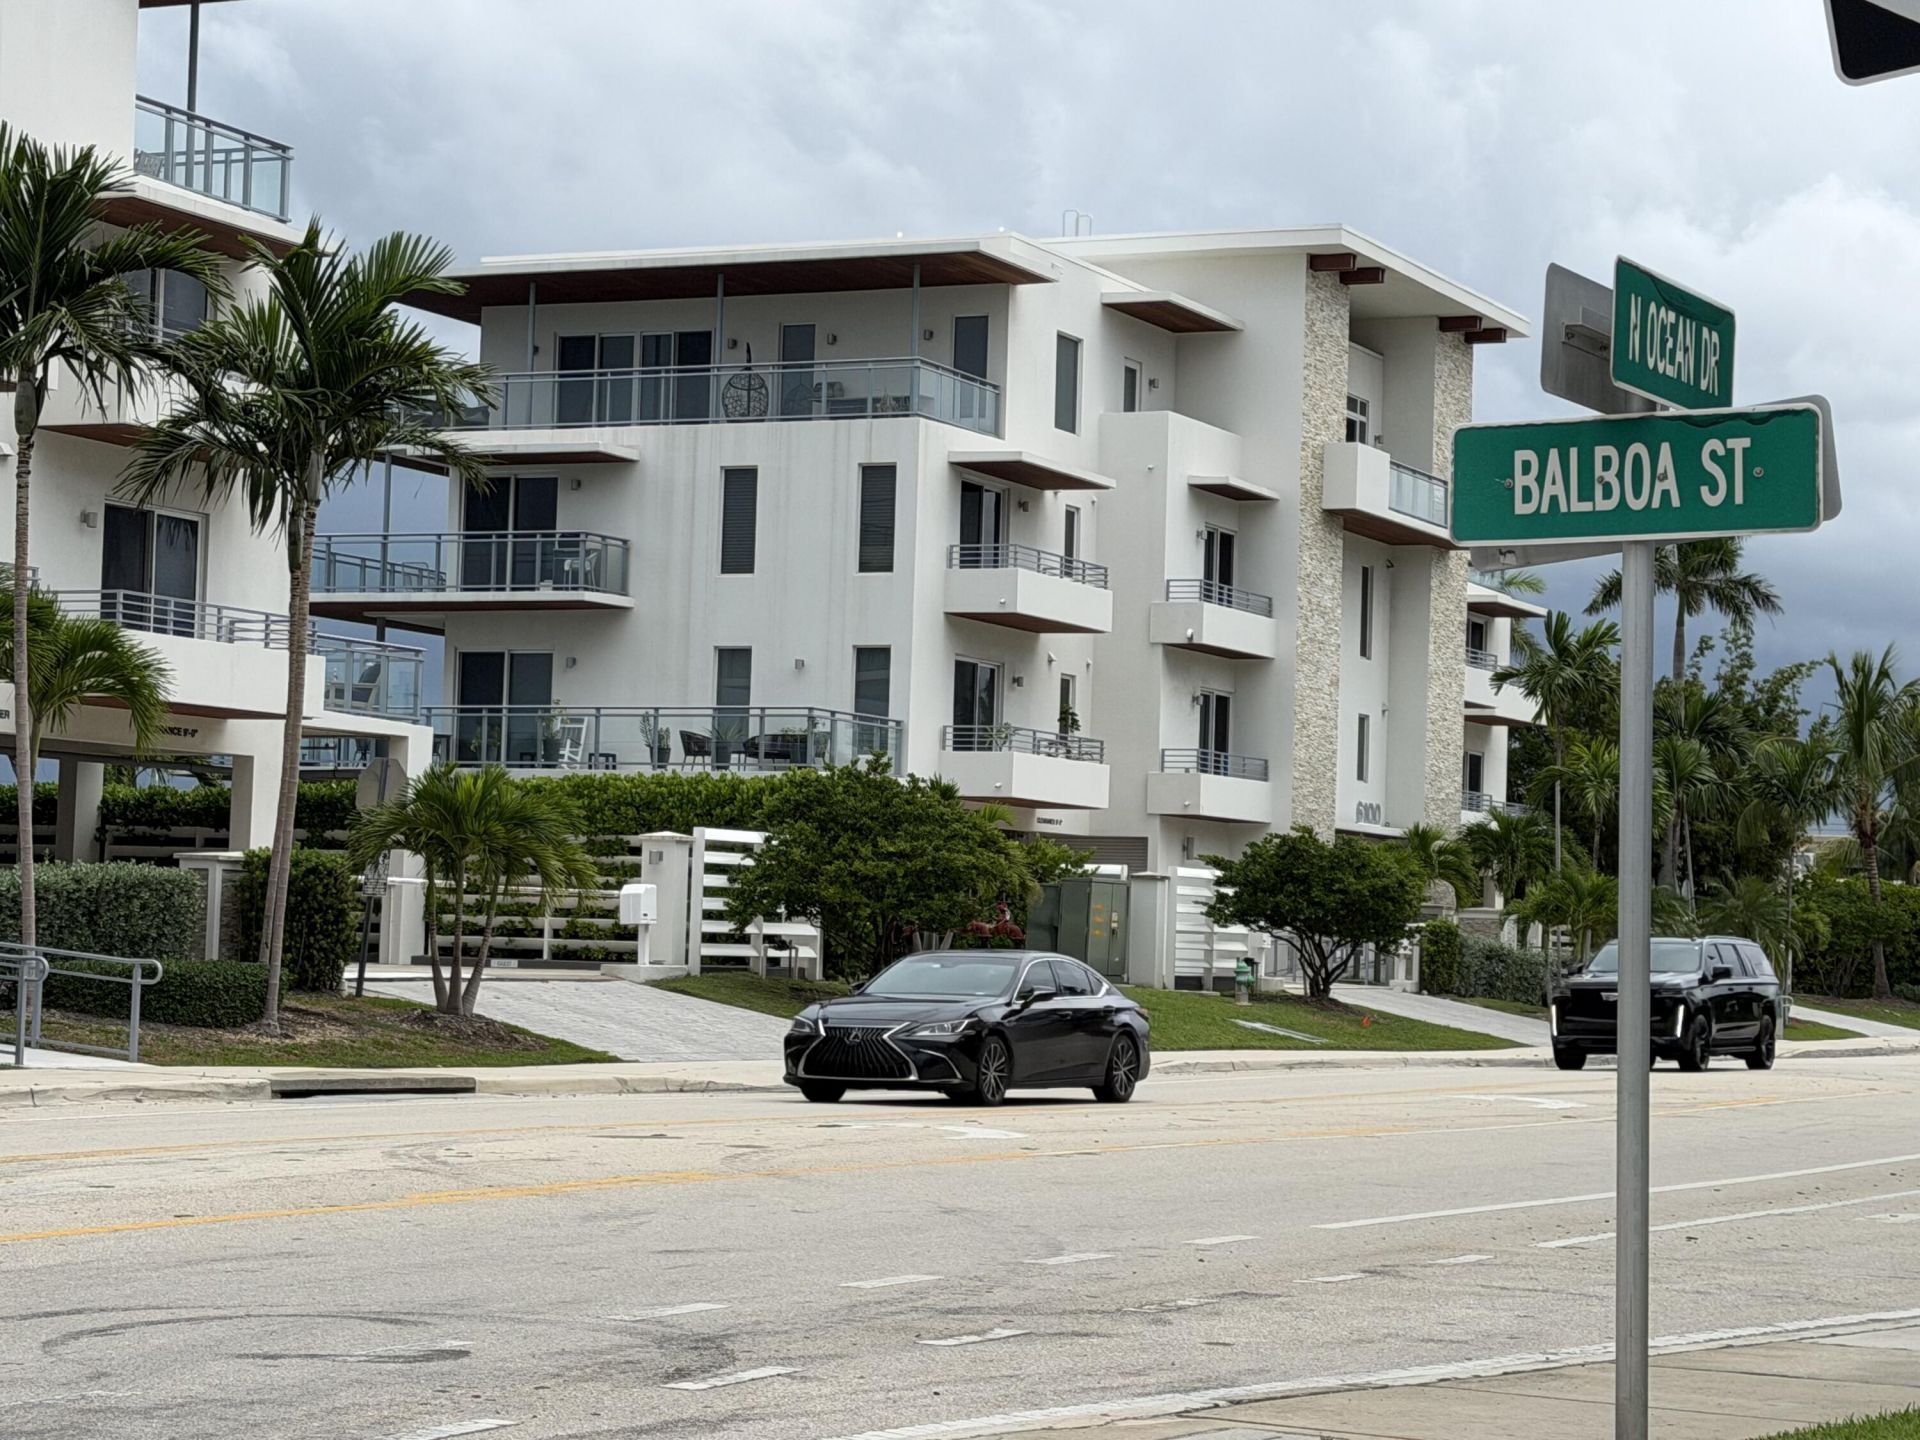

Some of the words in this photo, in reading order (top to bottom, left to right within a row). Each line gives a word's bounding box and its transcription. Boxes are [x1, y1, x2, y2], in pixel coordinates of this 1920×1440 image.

[1629, 293, 1641, 363] N
[1647, 301, 1696, 386] OCEAN
[1701, 326, 1719, 396] DR
[1514, 442, 1680, 515] BALBOA
[1700, 437, 1751, 507] ST
[1355, 800, 1382, 825] 6100
